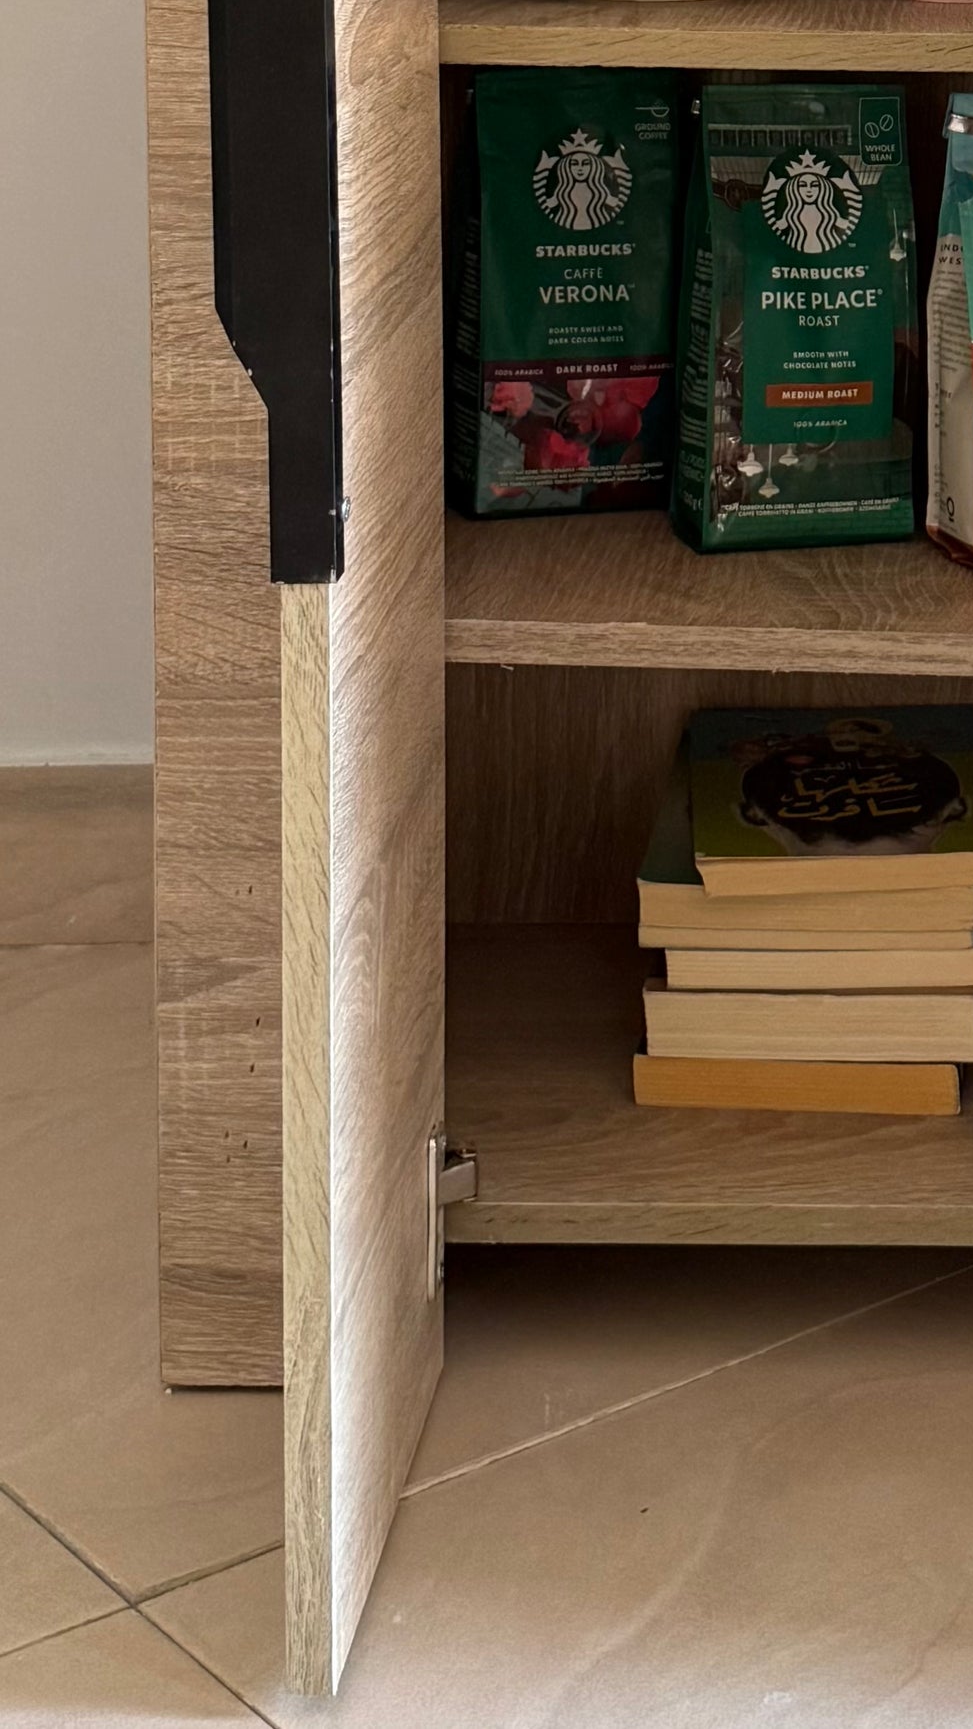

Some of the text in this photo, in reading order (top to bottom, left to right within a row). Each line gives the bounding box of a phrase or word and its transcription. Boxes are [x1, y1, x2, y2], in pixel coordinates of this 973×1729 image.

[864, 144, 896, 153] WHOLE
[869, 153, 893, 162] BEAN
[535, 243, 634, 258] STARBUCKS
[563, 267, 604, 280] CAFFÈ
[771, 266, 866, 280] STARBUCKS
[538, 284, 630, 304] VERONA
[761, 288, 878, 310] PIKE PLACE
[798, 315, 840, 327] ROAST
[793, 350, 849, 359] SMOOTH WITH
[556, 363, 619, 375] DARK ROAST
[783, 360, 856, 370] CHOCOLATE NOTES
[781, 388, 859, 400] MEDIUM ROAST
